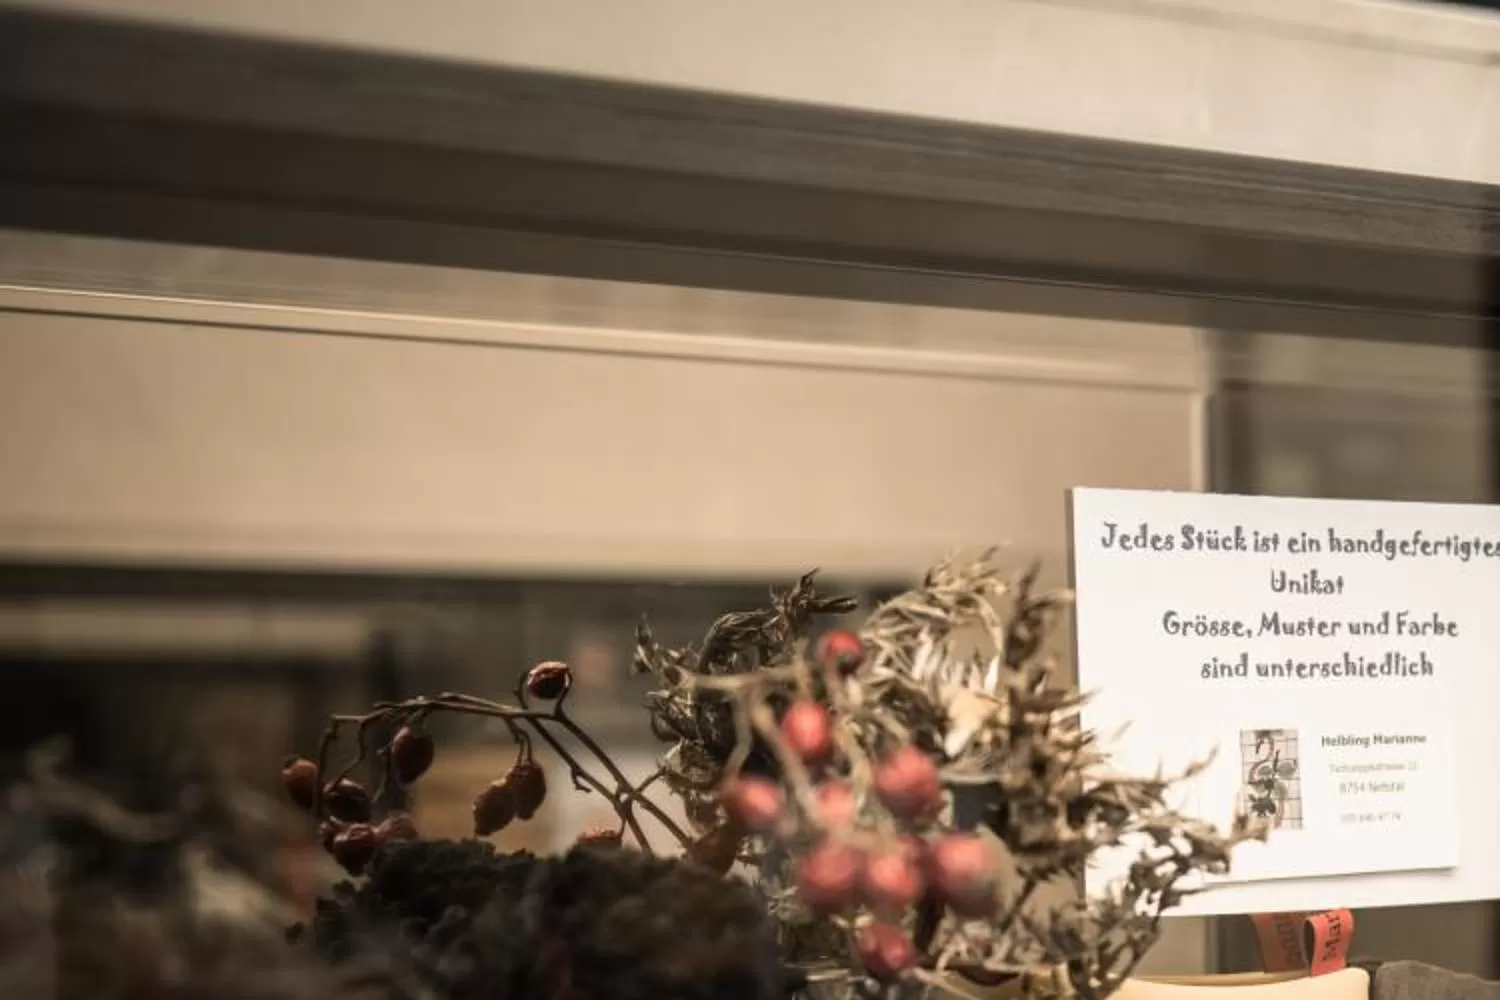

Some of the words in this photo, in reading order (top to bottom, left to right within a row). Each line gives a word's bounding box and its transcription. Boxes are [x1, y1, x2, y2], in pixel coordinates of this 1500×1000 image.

[1101, 521, 1175, 551] Jedes
[1180, 524, 1247, 551] Stück
[1253, 530, 1279, 552] ist
[1287, 532, 1321, 553] ein
[1271, 568, 1344, 595] Unikat
[1162, 610, 1253, 638] Grösse,
[1257, 611, 1342, 637] Muster
[1348, 611, 1390, 636] und
[1396, 610, 1459, 637] Farbe
[1200, 652, 1249, 679] sind
[1256, 651, 1434, 678] unterschiedlich
[1321, 735, 1370, 748] Helbling
[1373, 733, 1427, 745] Marianne
